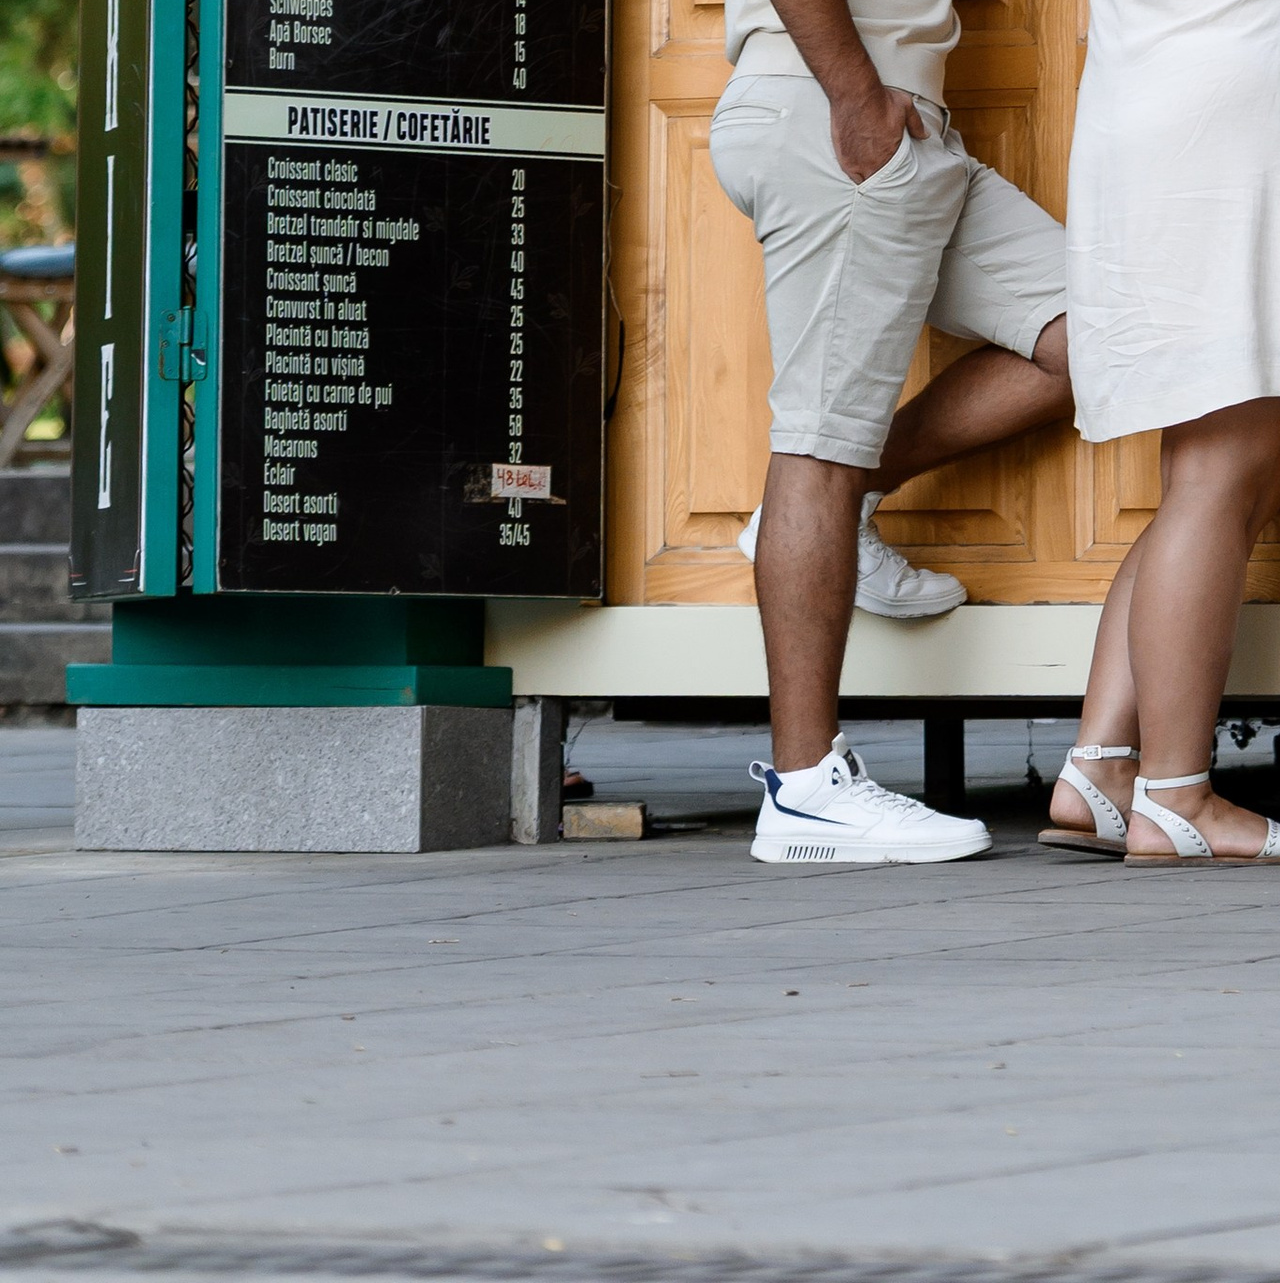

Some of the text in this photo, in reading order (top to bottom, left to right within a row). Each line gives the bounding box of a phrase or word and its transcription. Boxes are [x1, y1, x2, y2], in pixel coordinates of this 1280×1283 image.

[293, 20, 332, 45] Borsec
[268, 46, 296, 71] Burn
[288, 106, 378, 140] PATISERIE
[397, 108, 491, 145] COFETĂRIE
[267, 156, 358, 183] Croissant clasic
[511, 168, 525, 191] 20
[267, 183, 321, 209] Croissant
[511, 195, 525, 218] 25
[267, 211, 420, 245] Bretzel trandafir si migdale
[266, 295, 321, 320] Crenvurst
[337, 298, 367, 322] aluat
[314, 329, 329, 348] cu
[265, 378, 392, 410] Foietaj cu carne de pui
[313, 409, 347, 432] asorti
[508, 414, 523, 437] 58
[264, 434, 318, 459] Macarons
[508, 441, 522, 464] 32
[263, 490, 338, 515] Desert asorti
[263, 518, 337, 547] Desert vegan
[499, 523, 530, 547] 35/45
